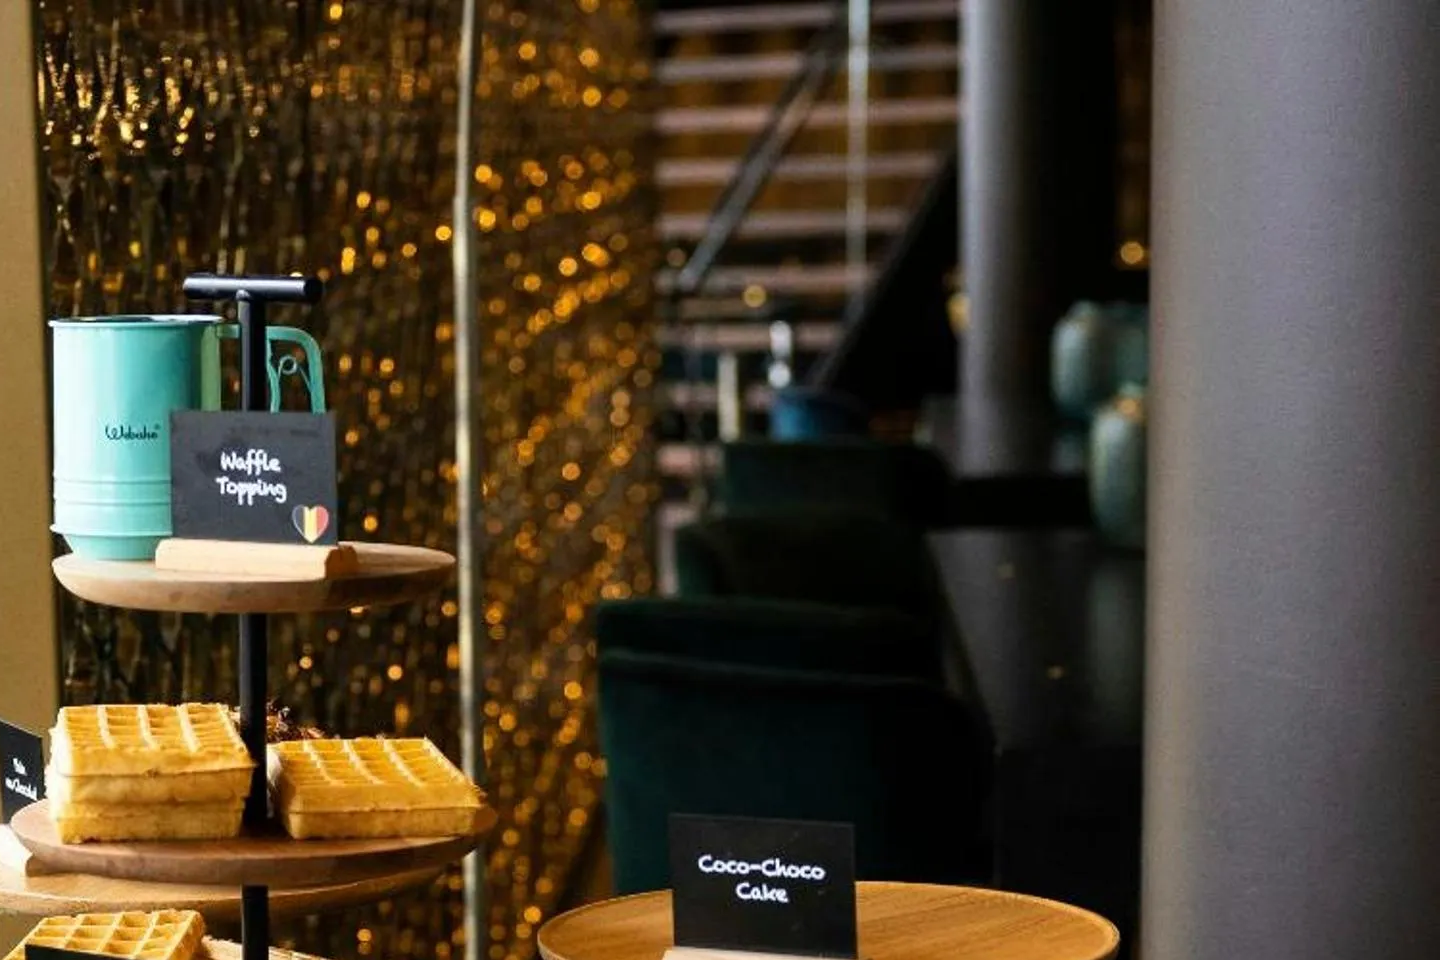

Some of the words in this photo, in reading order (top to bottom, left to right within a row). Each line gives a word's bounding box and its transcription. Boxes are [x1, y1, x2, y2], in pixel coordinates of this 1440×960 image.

[220, 449, 281, 475] Waffle
[215, 476, 287, 505] Topping
[697, 854, 826, 880] Coco-Choco
[735, 882, 790, 904] Cake
